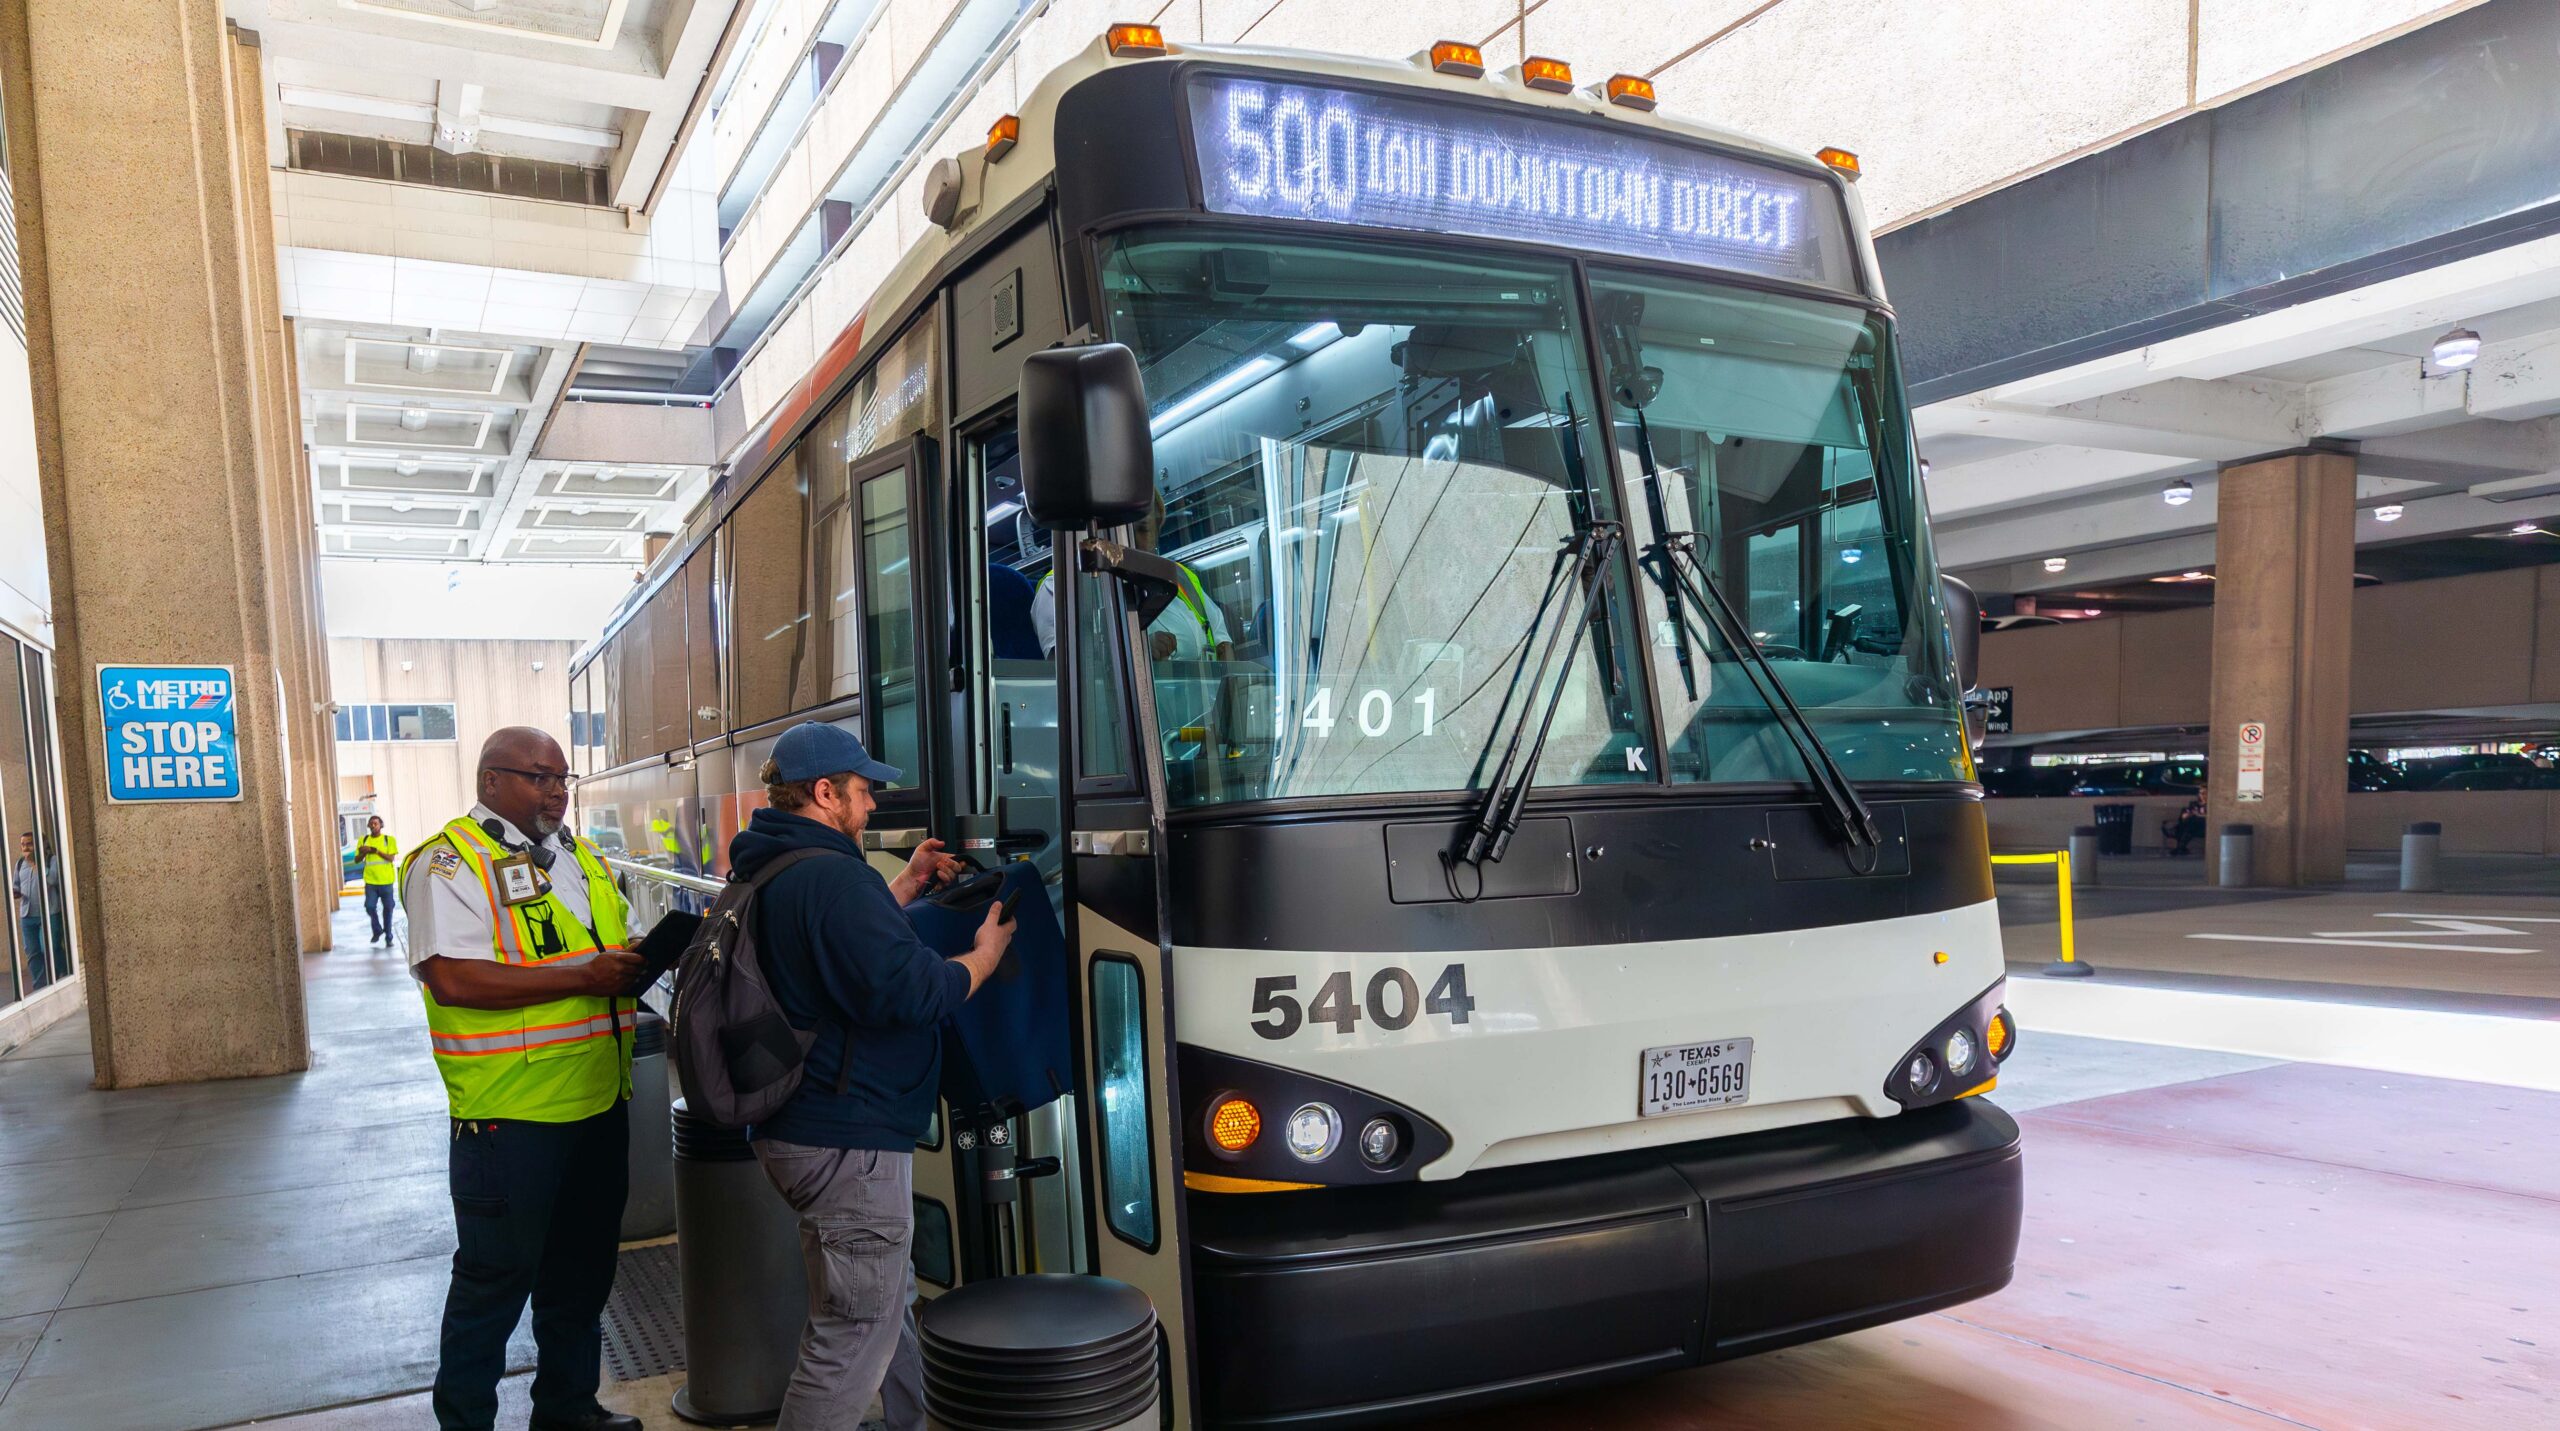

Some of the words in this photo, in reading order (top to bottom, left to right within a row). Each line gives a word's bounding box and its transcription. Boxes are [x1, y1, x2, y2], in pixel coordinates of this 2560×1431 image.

[1227, 86, 1356, 209] 500
[1366, 129, 1437, 198] IAH
[1452, 144, 1660, 230] DOWNTOWN
[1670, 178, 1797, 248] DIRECT
[137, 680, 227, 695] METRO
[1987, 690, 2008, 703] App
[138, 695, 189, 710] LIFT
[121, 721, 222, 754] STOP
[1626, 747, 1648, 771] K
[122, 755, 227, 788] HERE
[1251, 963, 1475, 1040] 5404
[1679, 1045, 1721, 1061] TEXAS
[1686, 1059, 1711, 1067] EXEMPT
[1650, 1070, 1686, 1103] 130
[1697, 1062, 1744, 1096] 6569
